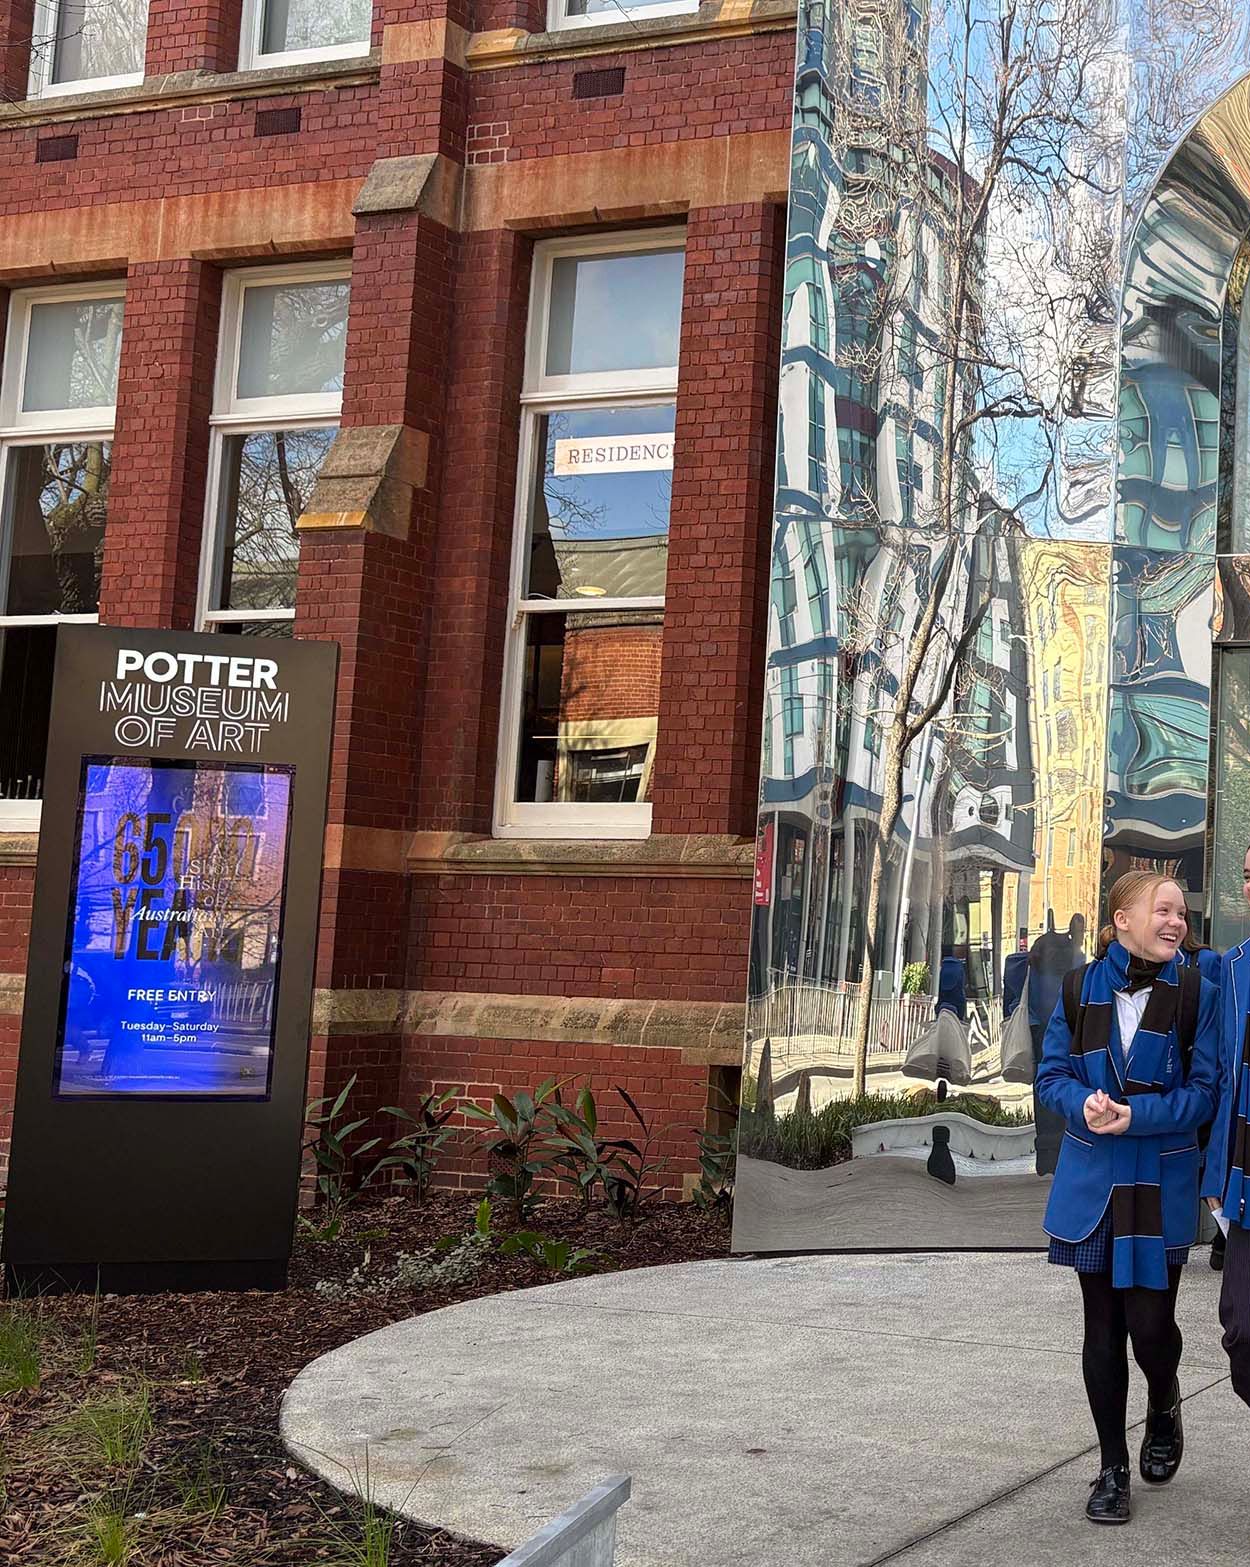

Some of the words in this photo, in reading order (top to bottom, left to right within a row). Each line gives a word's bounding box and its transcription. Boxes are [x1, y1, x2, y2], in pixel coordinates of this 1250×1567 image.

[567, 442, 675, 464] RESIDENC
[116, 649, 279, 689] POTTER
[99, 681, 290, 722] MUSEUM
[115, 715, 177, 747] OF
[184, 719, 271, 753] ART
[112, 812, 256, 888] 6500
[178, 874, 240, 895] Histo
[128, 989, 164, 1002] FREE
[168, 990, 217, 1003] ENTRY
